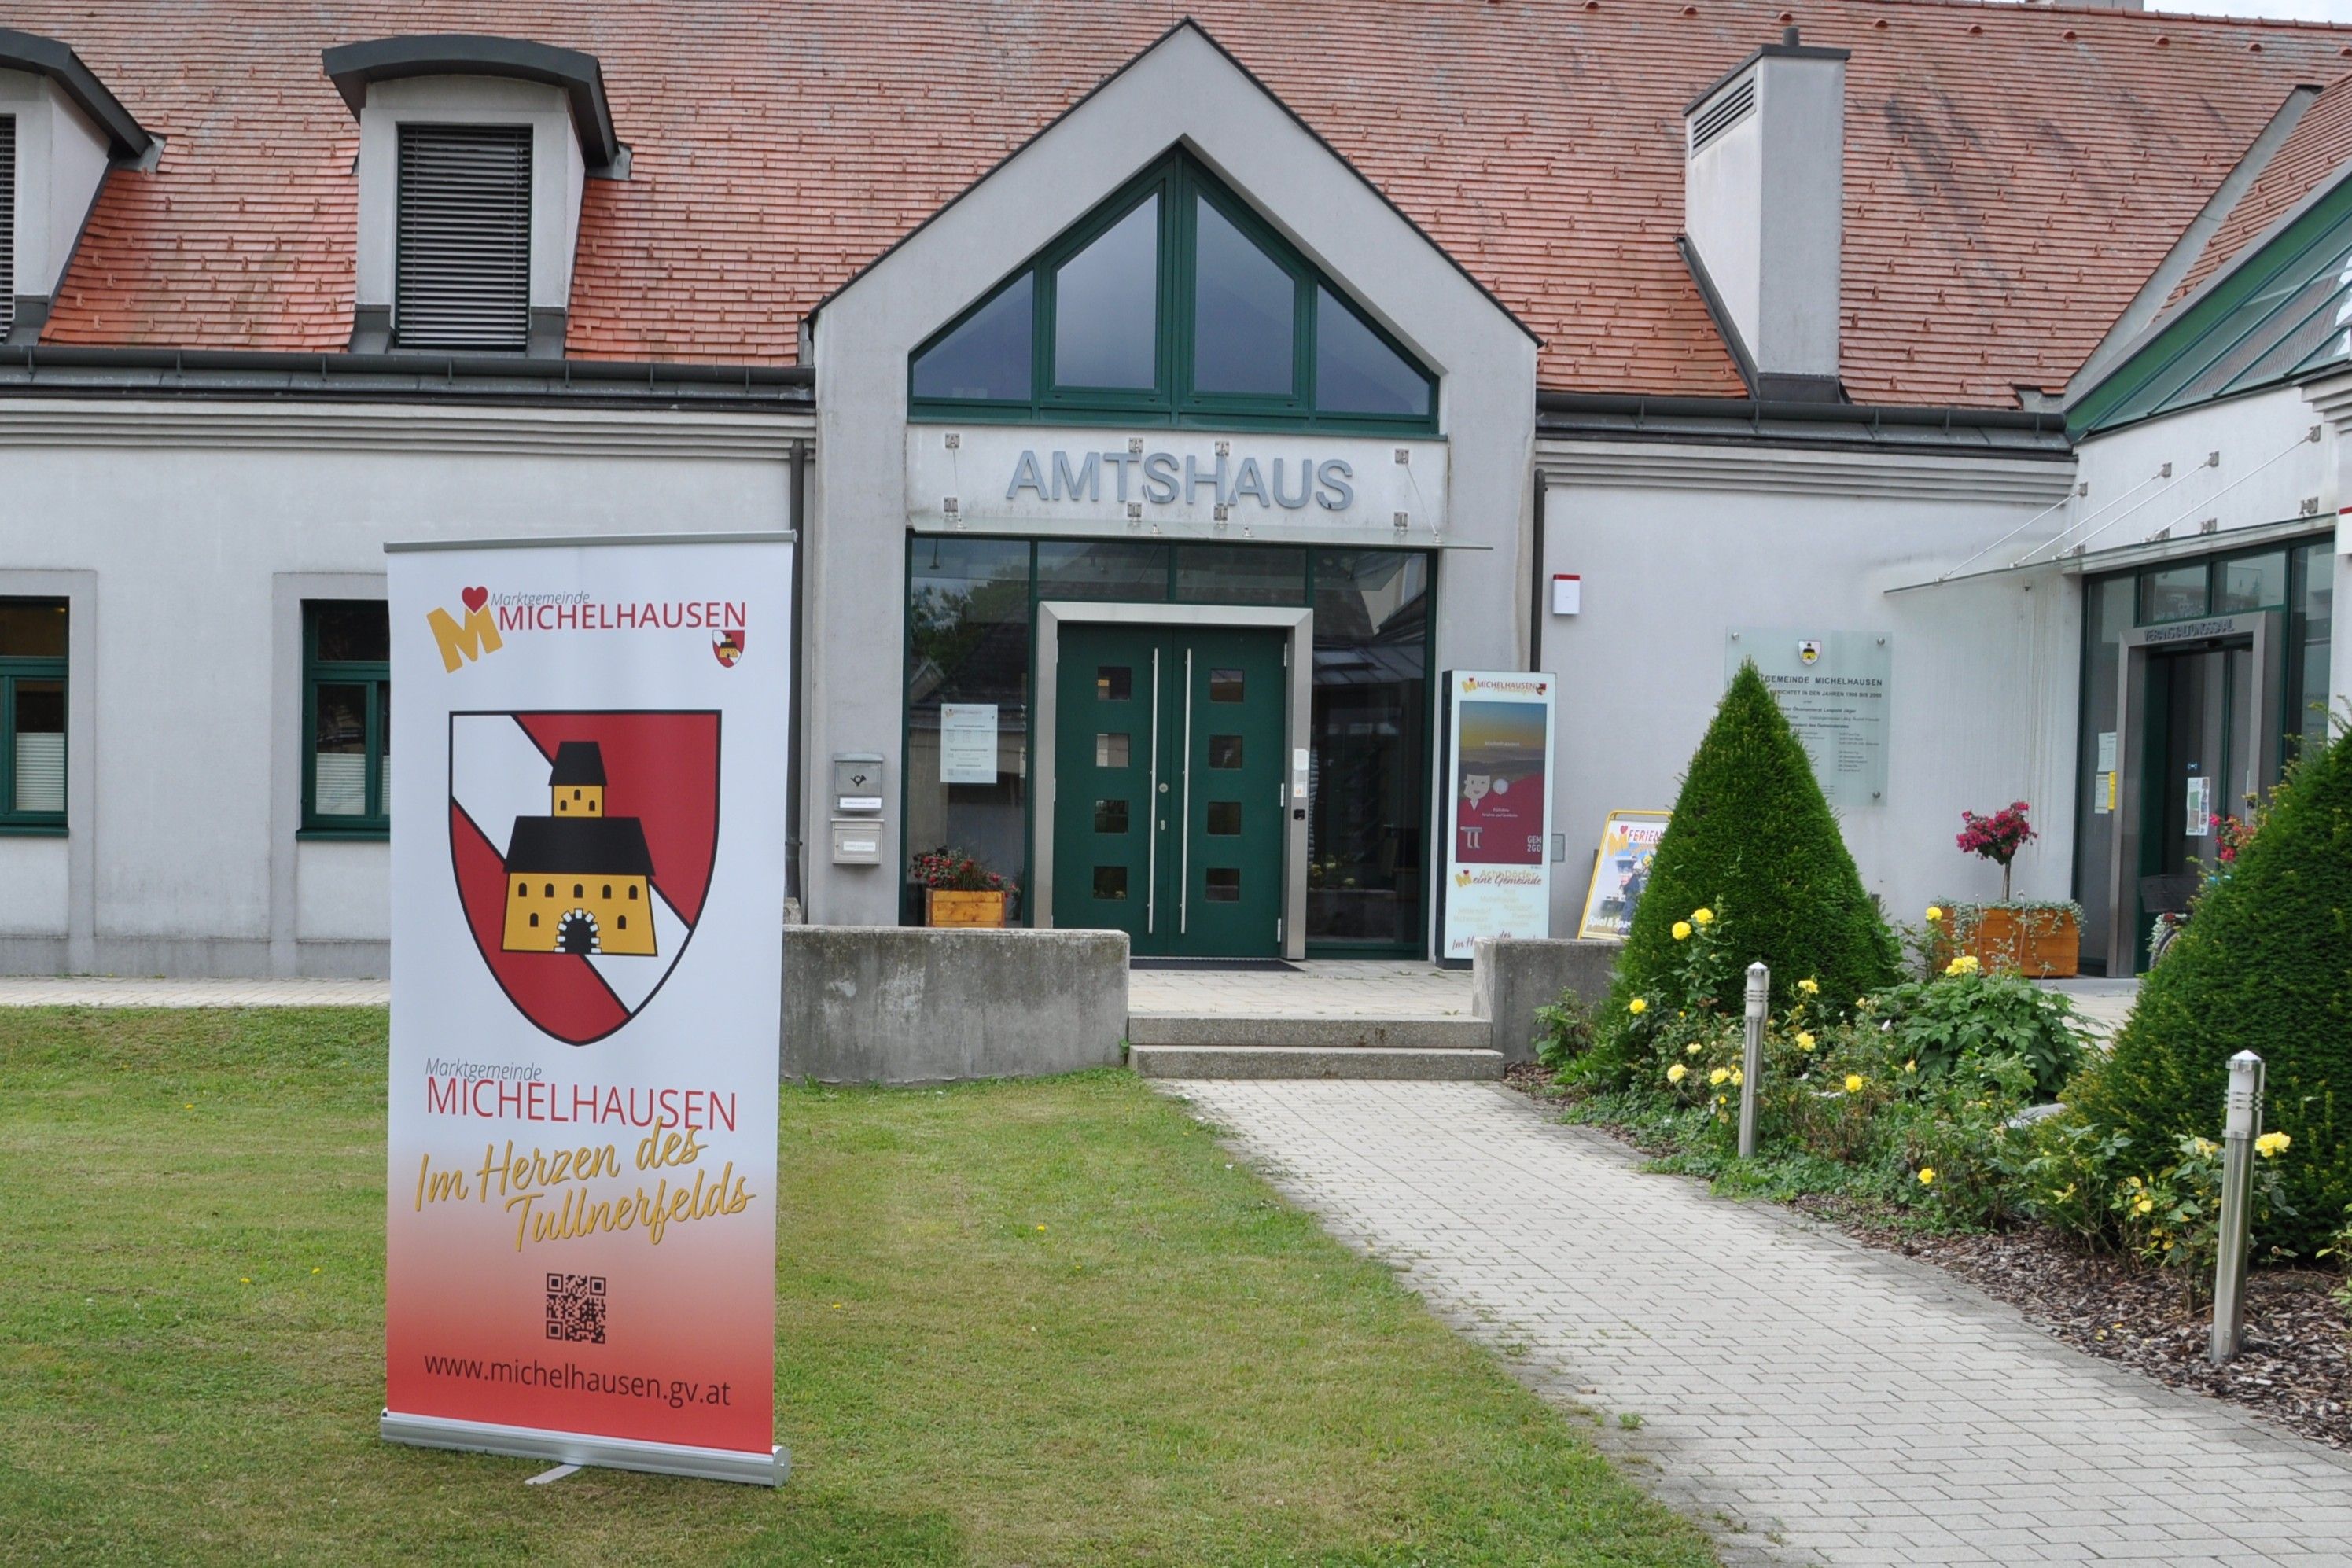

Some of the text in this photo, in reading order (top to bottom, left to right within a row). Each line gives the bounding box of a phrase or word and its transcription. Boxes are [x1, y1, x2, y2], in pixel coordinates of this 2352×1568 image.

[1006, 449, 1354, 510] AMTSHAUS
[491, 591, 591, 611] Marktgemeinde
[499, 602, 746, 631] MICHELHAUSEN
[1477, 681, 1535, 690] MICHELHAUSEN
[1765, 675, 1883, 686] GEMEINDE MICHELHAUSEN
[1494, 874, 1542, 887] Gemeinde
[425, 1058, 543, 1083] Marktgemeinde
[427, 1076, 737, 1132] MICHELHAUSEN
[414, 1115, 708, 1211] Im Herzen des
[504, 1161, 757, 1252] Tullnerfelds
[424, 1354, 731, 1408] www.michelhausen.gv.at
